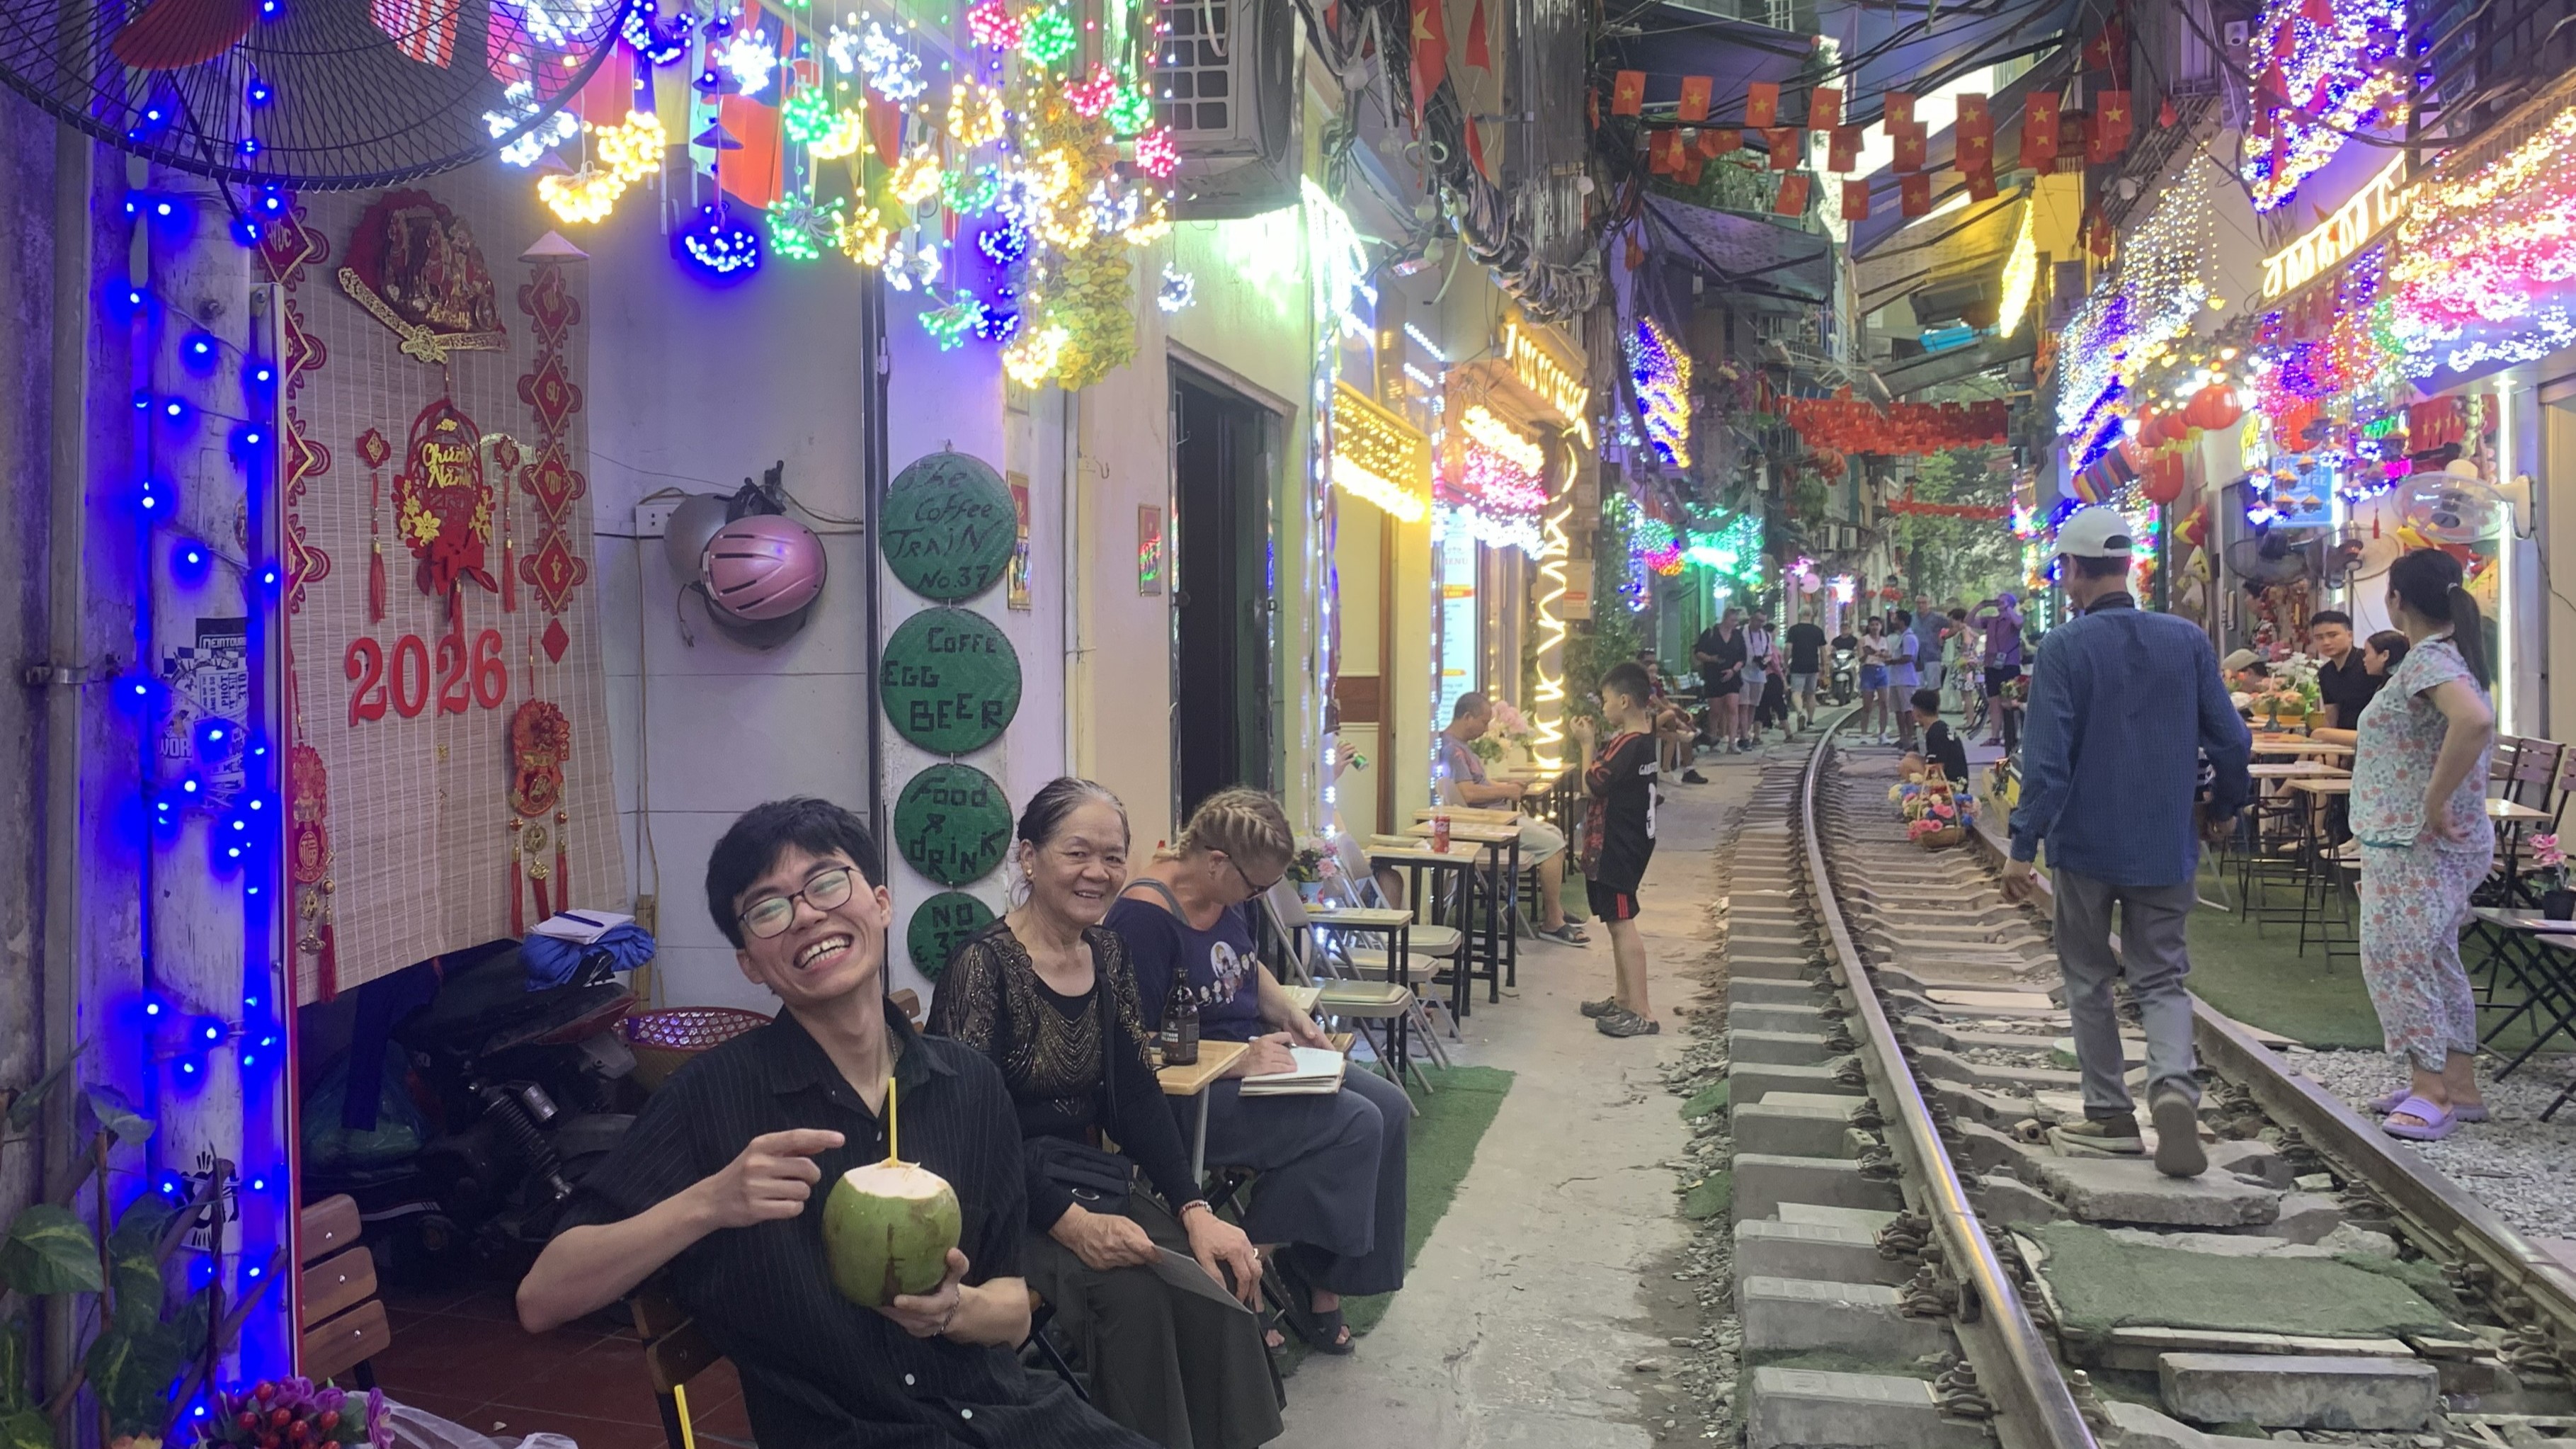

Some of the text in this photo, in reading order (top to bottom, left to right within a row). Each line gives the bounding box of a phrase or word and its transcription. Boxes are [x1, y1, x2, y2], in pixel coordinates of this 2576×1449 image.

[915, 491, 991, 525] Coffee
[344, 629, 508, 727] 2026
[883, 660, 940, 688] EGG
[910, 693, 1003, 732] BEER
